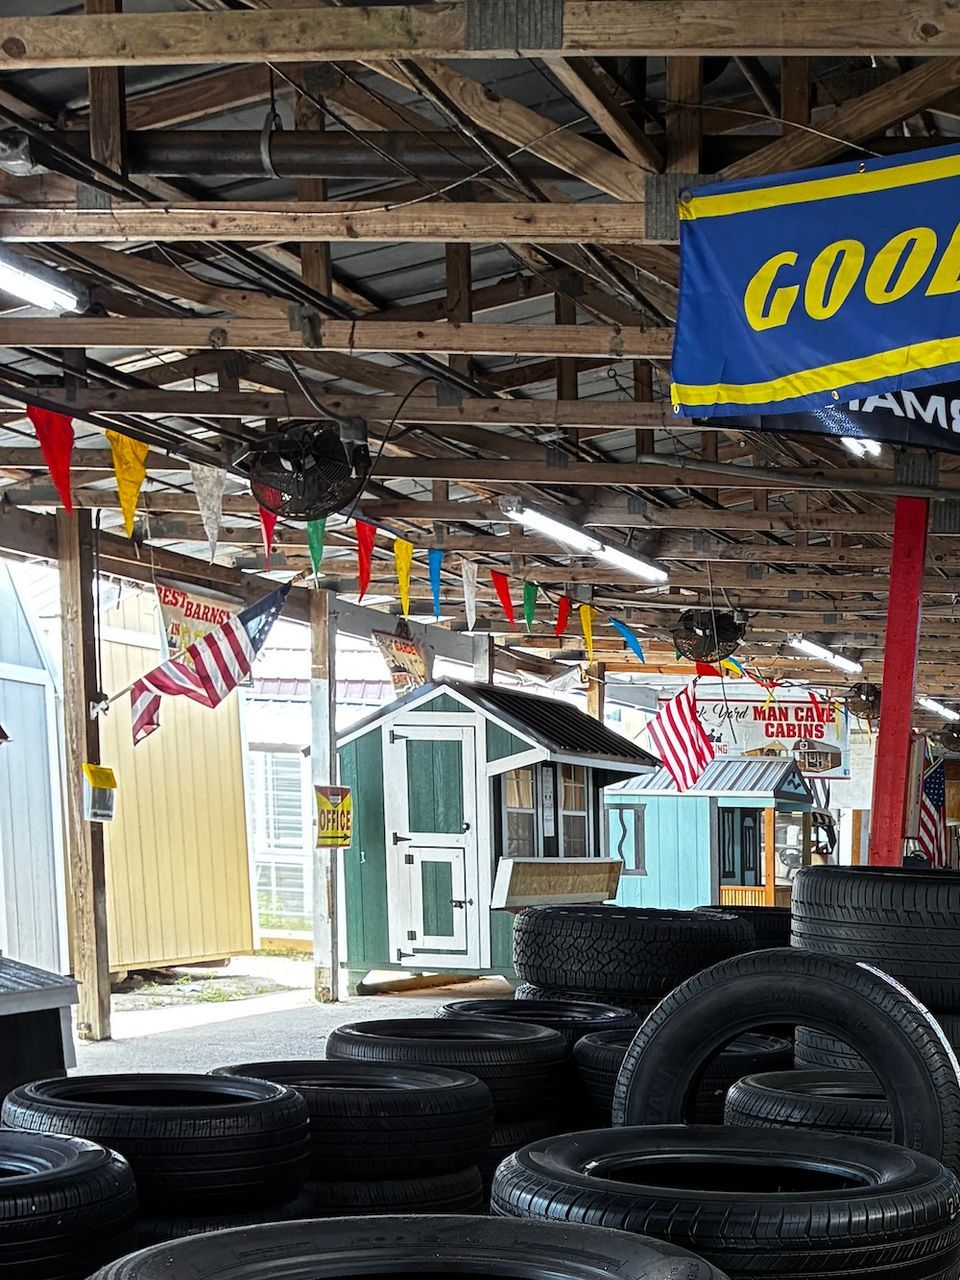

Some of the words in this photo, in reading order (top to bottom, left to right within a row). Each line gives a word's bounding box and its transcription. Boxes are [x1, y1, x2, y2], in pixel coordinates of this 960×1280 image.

[753, 705, 792, 722] MAN
[765, 722, 825, 739] CABINS
[319, 809, 351, 831] OFFICE
